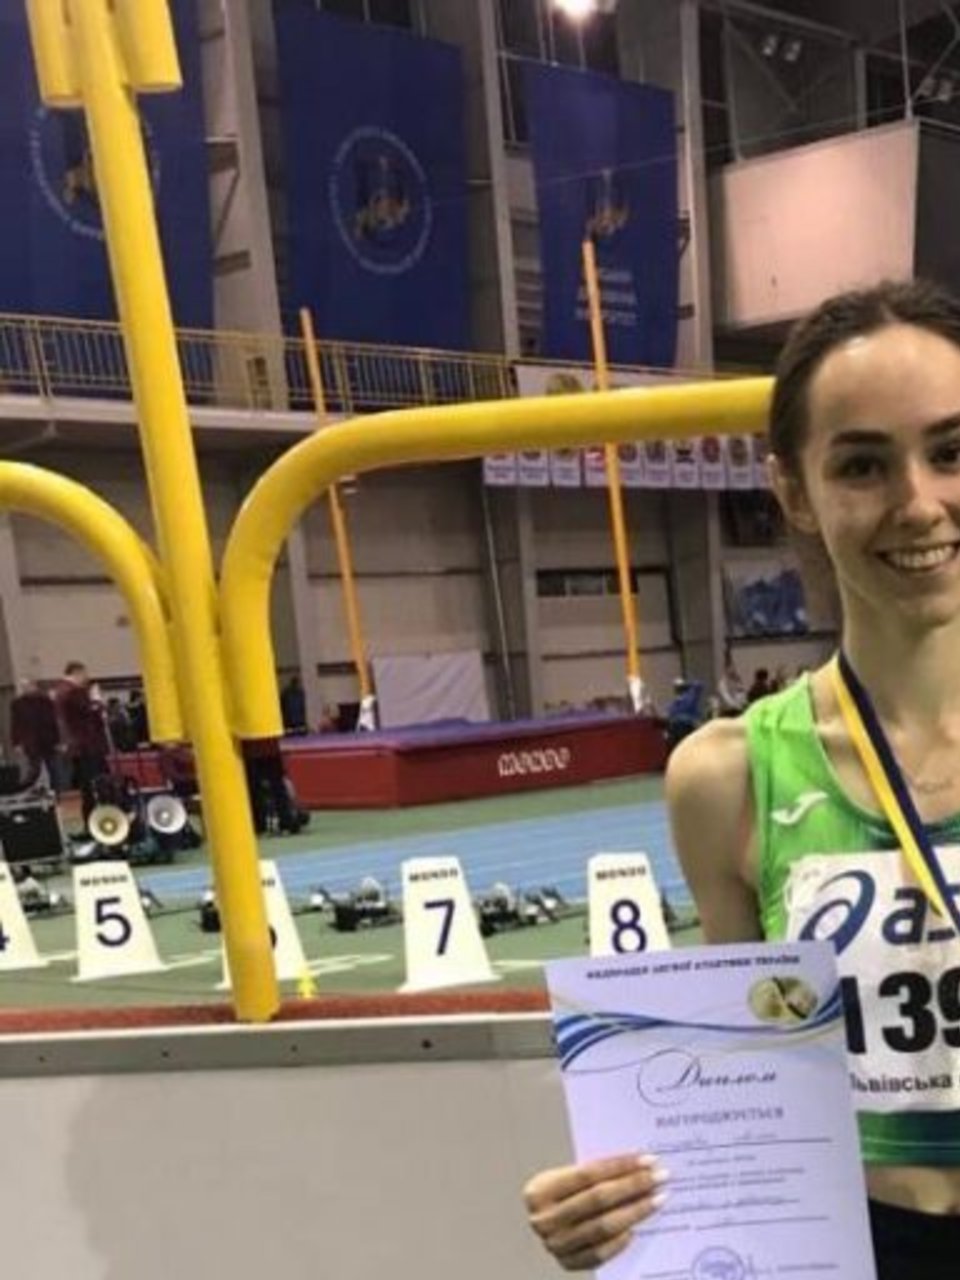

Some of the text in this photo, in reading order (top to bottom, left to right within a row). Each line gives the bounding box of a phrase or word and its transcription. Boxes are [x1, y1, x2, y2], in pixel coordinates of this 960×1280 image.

[95, 896, 132, 947] 5
[424, 899, 456, 956] 7
[610, 899, 648, 953] 8
